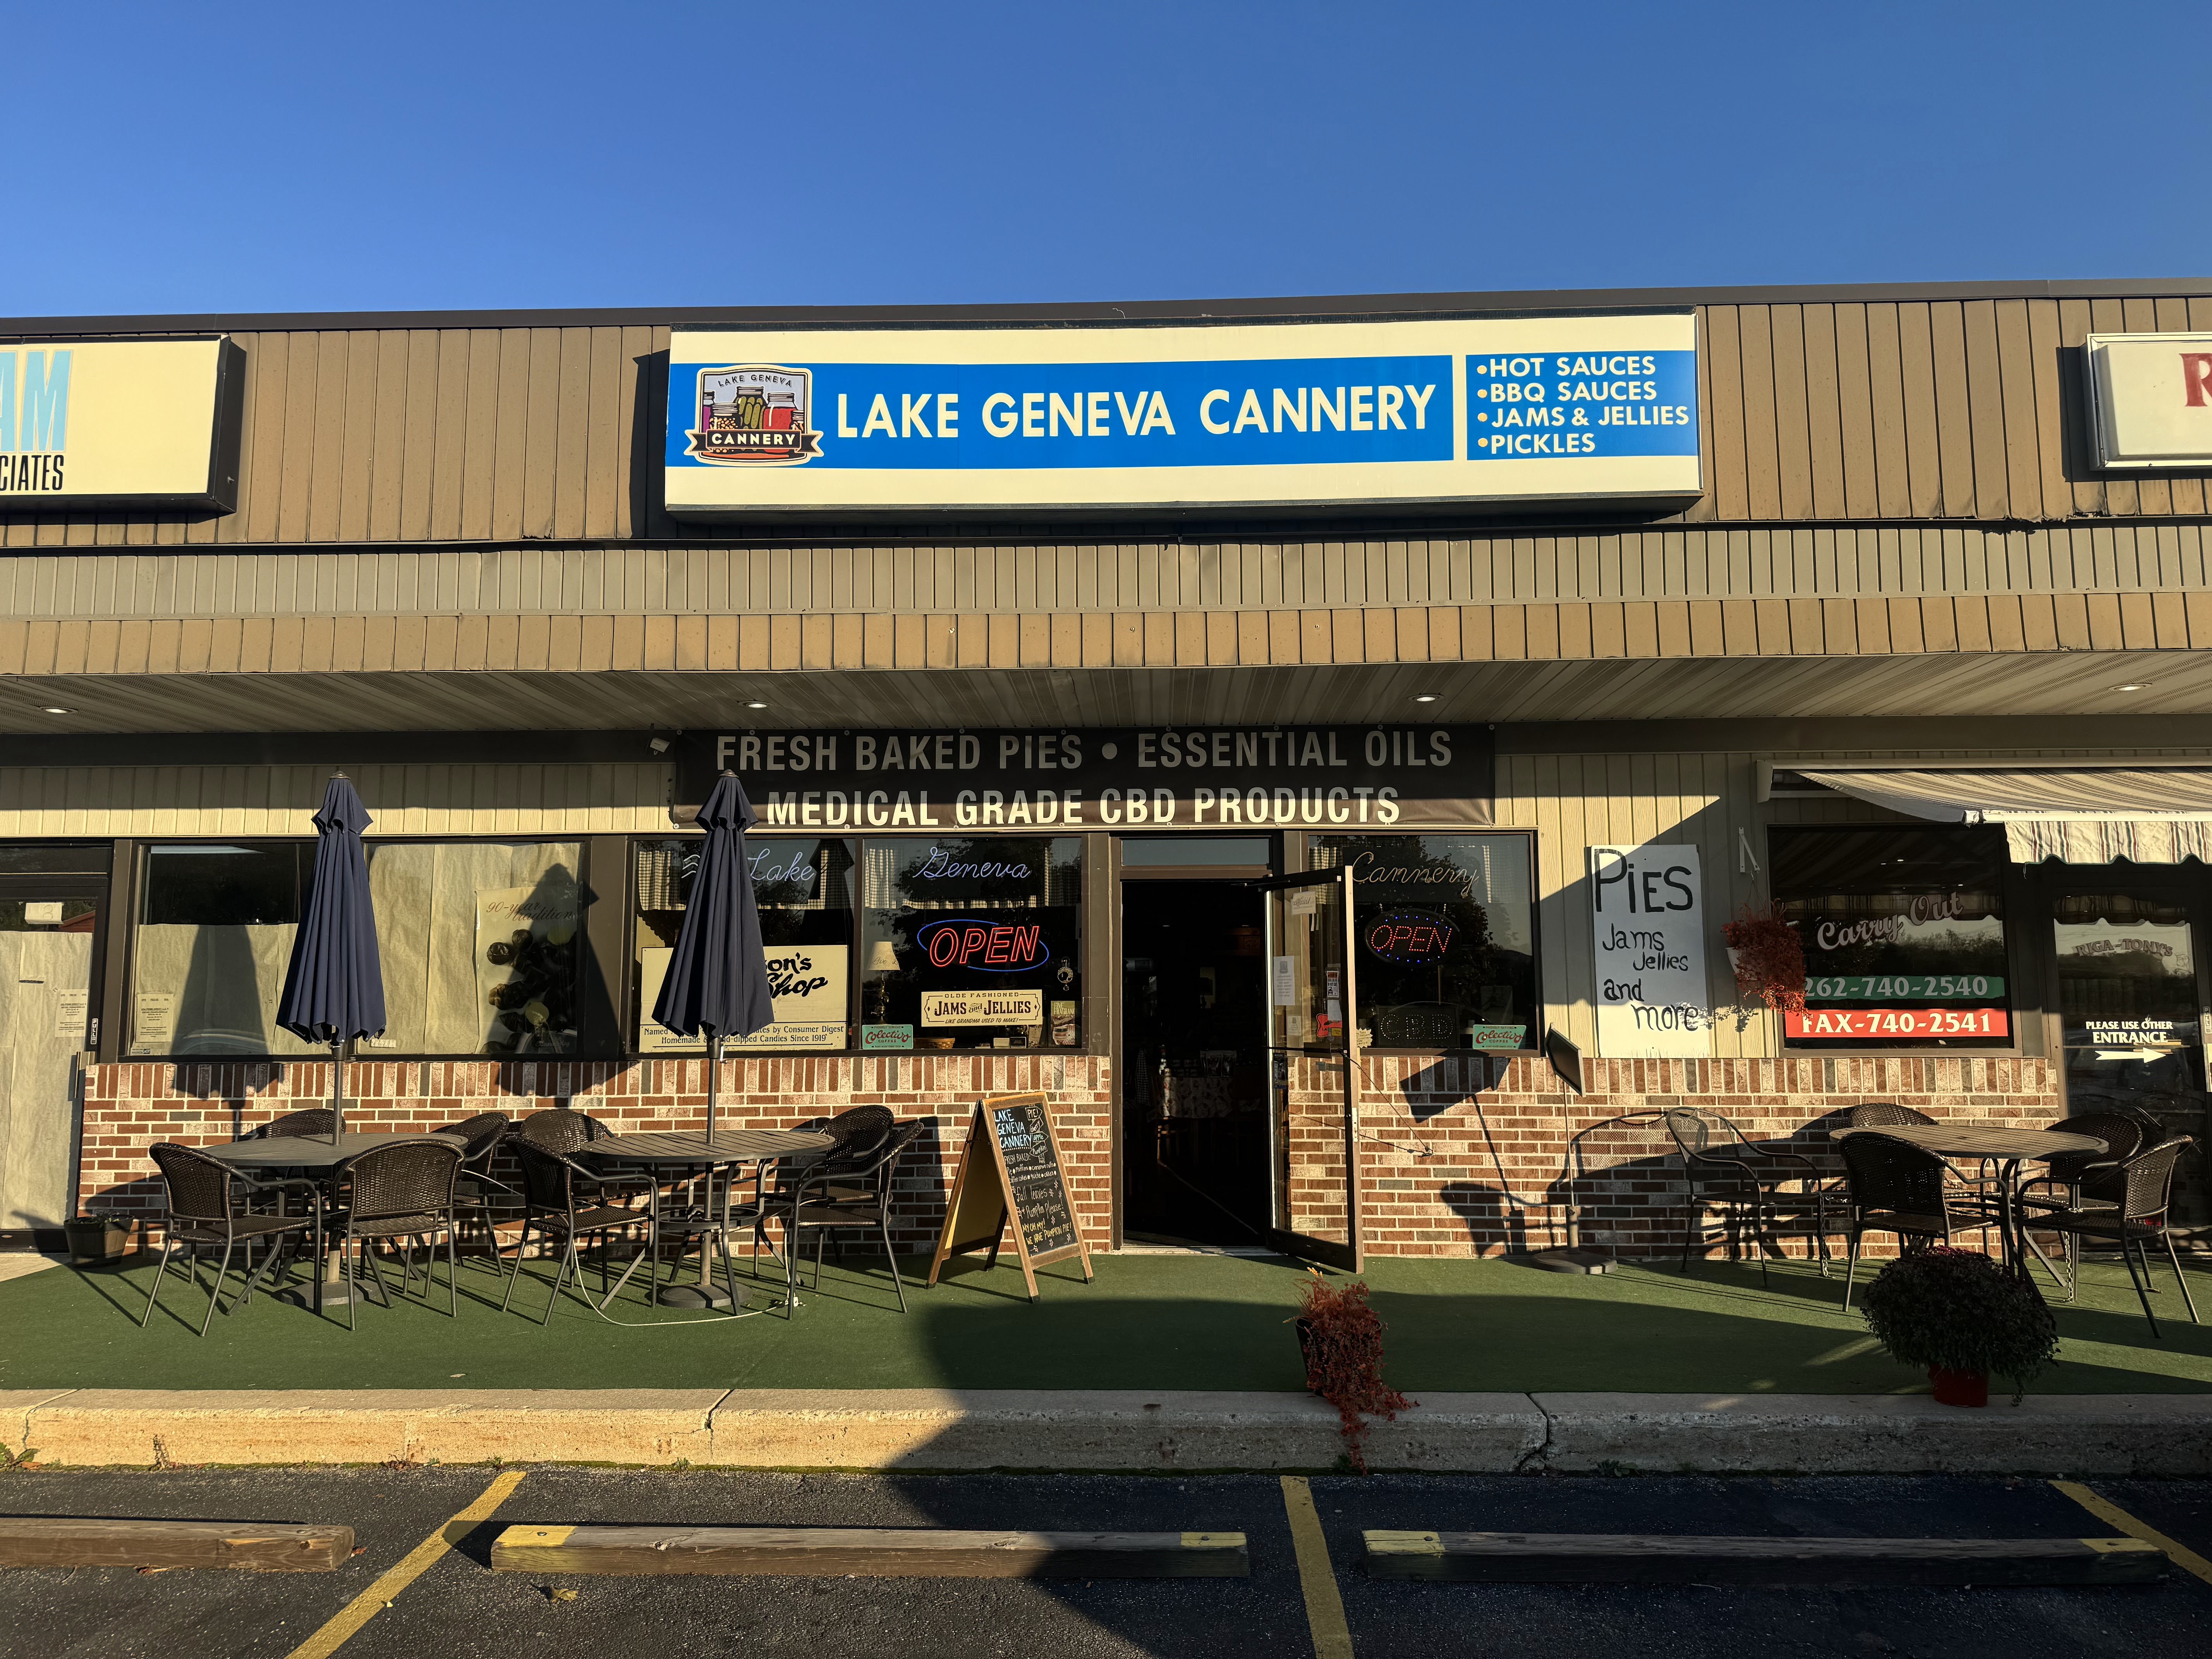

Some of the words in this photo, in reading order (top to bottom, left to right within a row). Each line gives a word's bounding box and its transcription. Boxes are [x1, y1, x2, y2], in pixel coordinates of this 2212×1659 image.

[1490, 358, 1544, 377] HOT
[1557, 356, 1656, 376] SAUCES
[718, 375, 744, 388] LAKE
[751, 374, 792, 388] GENEVA
[1491, 383, 1545, 402] BBQ
[1558, 381, 1657, 401] SAUCES
[838, 393, 958, 438] LAKE
[982, 391, 1176, 438] GENEVA
[1200, 385, 1436, 434] CANNERY
[1492, 407, 1565, 427] JAMS
[1571, 407, 1590, 426] &
[1598, 406, 1689, 426] JELLIES
[712, 433, 795, 445] CANNERY
[1491, 433, 1595, 454] PICKLES
[716, 736, 837, 771] FRESH
[856, 735, 981, 770] BAKED
[1000, 734, 1083, 769] PIES
[1138, 732, 1347, 768] ESSENTIAL
[1365, 730, 1452, 767] OILS
[768, 790, 938, 826] MEDICAL
[955, 789, 1083, 825] GRADE
[1099, 788, 1176, 823] CBD
[1194, 787, 1400, 823] PRODUCTS
[747, 848, 816, 881] Lake
[912, 846, 1032, 878] Geneva
[1352, 852, 1479, 898] Cannery
[1817, 914, 1903, 950] Carry
[1910, 891, 1963, 926] Out
[930, 926, 1039, 967] OPEN
[1371, 925, 1452, 952] OPEN
[1602, 923, 1665, 951] Jams
[1603, 978, 1645, 1002] and
[934, 1001, 967, 1016] JAMS
[984, 1000, 1031, 1015] JELLIES
[1631, 1001, 1698, 1031] more
[2086, 1021, 2119, 1029] PLEASE
[2142, 1021, 2173, 1029] OTHER
[723, 1034, 757, 1044] d-dipped
[866, 1030, 911, 1044] Colectivo
[1476, 1030, 1523, 1044] Colectivo
[2093, 1031, 2168, 1044] ENTRANCE
[993, 1109, 1014, 1122] LAKE
[997, 1121, 1025, 1135] GENEVA
[1000, 1134, 1032, 1148] CANNERY
